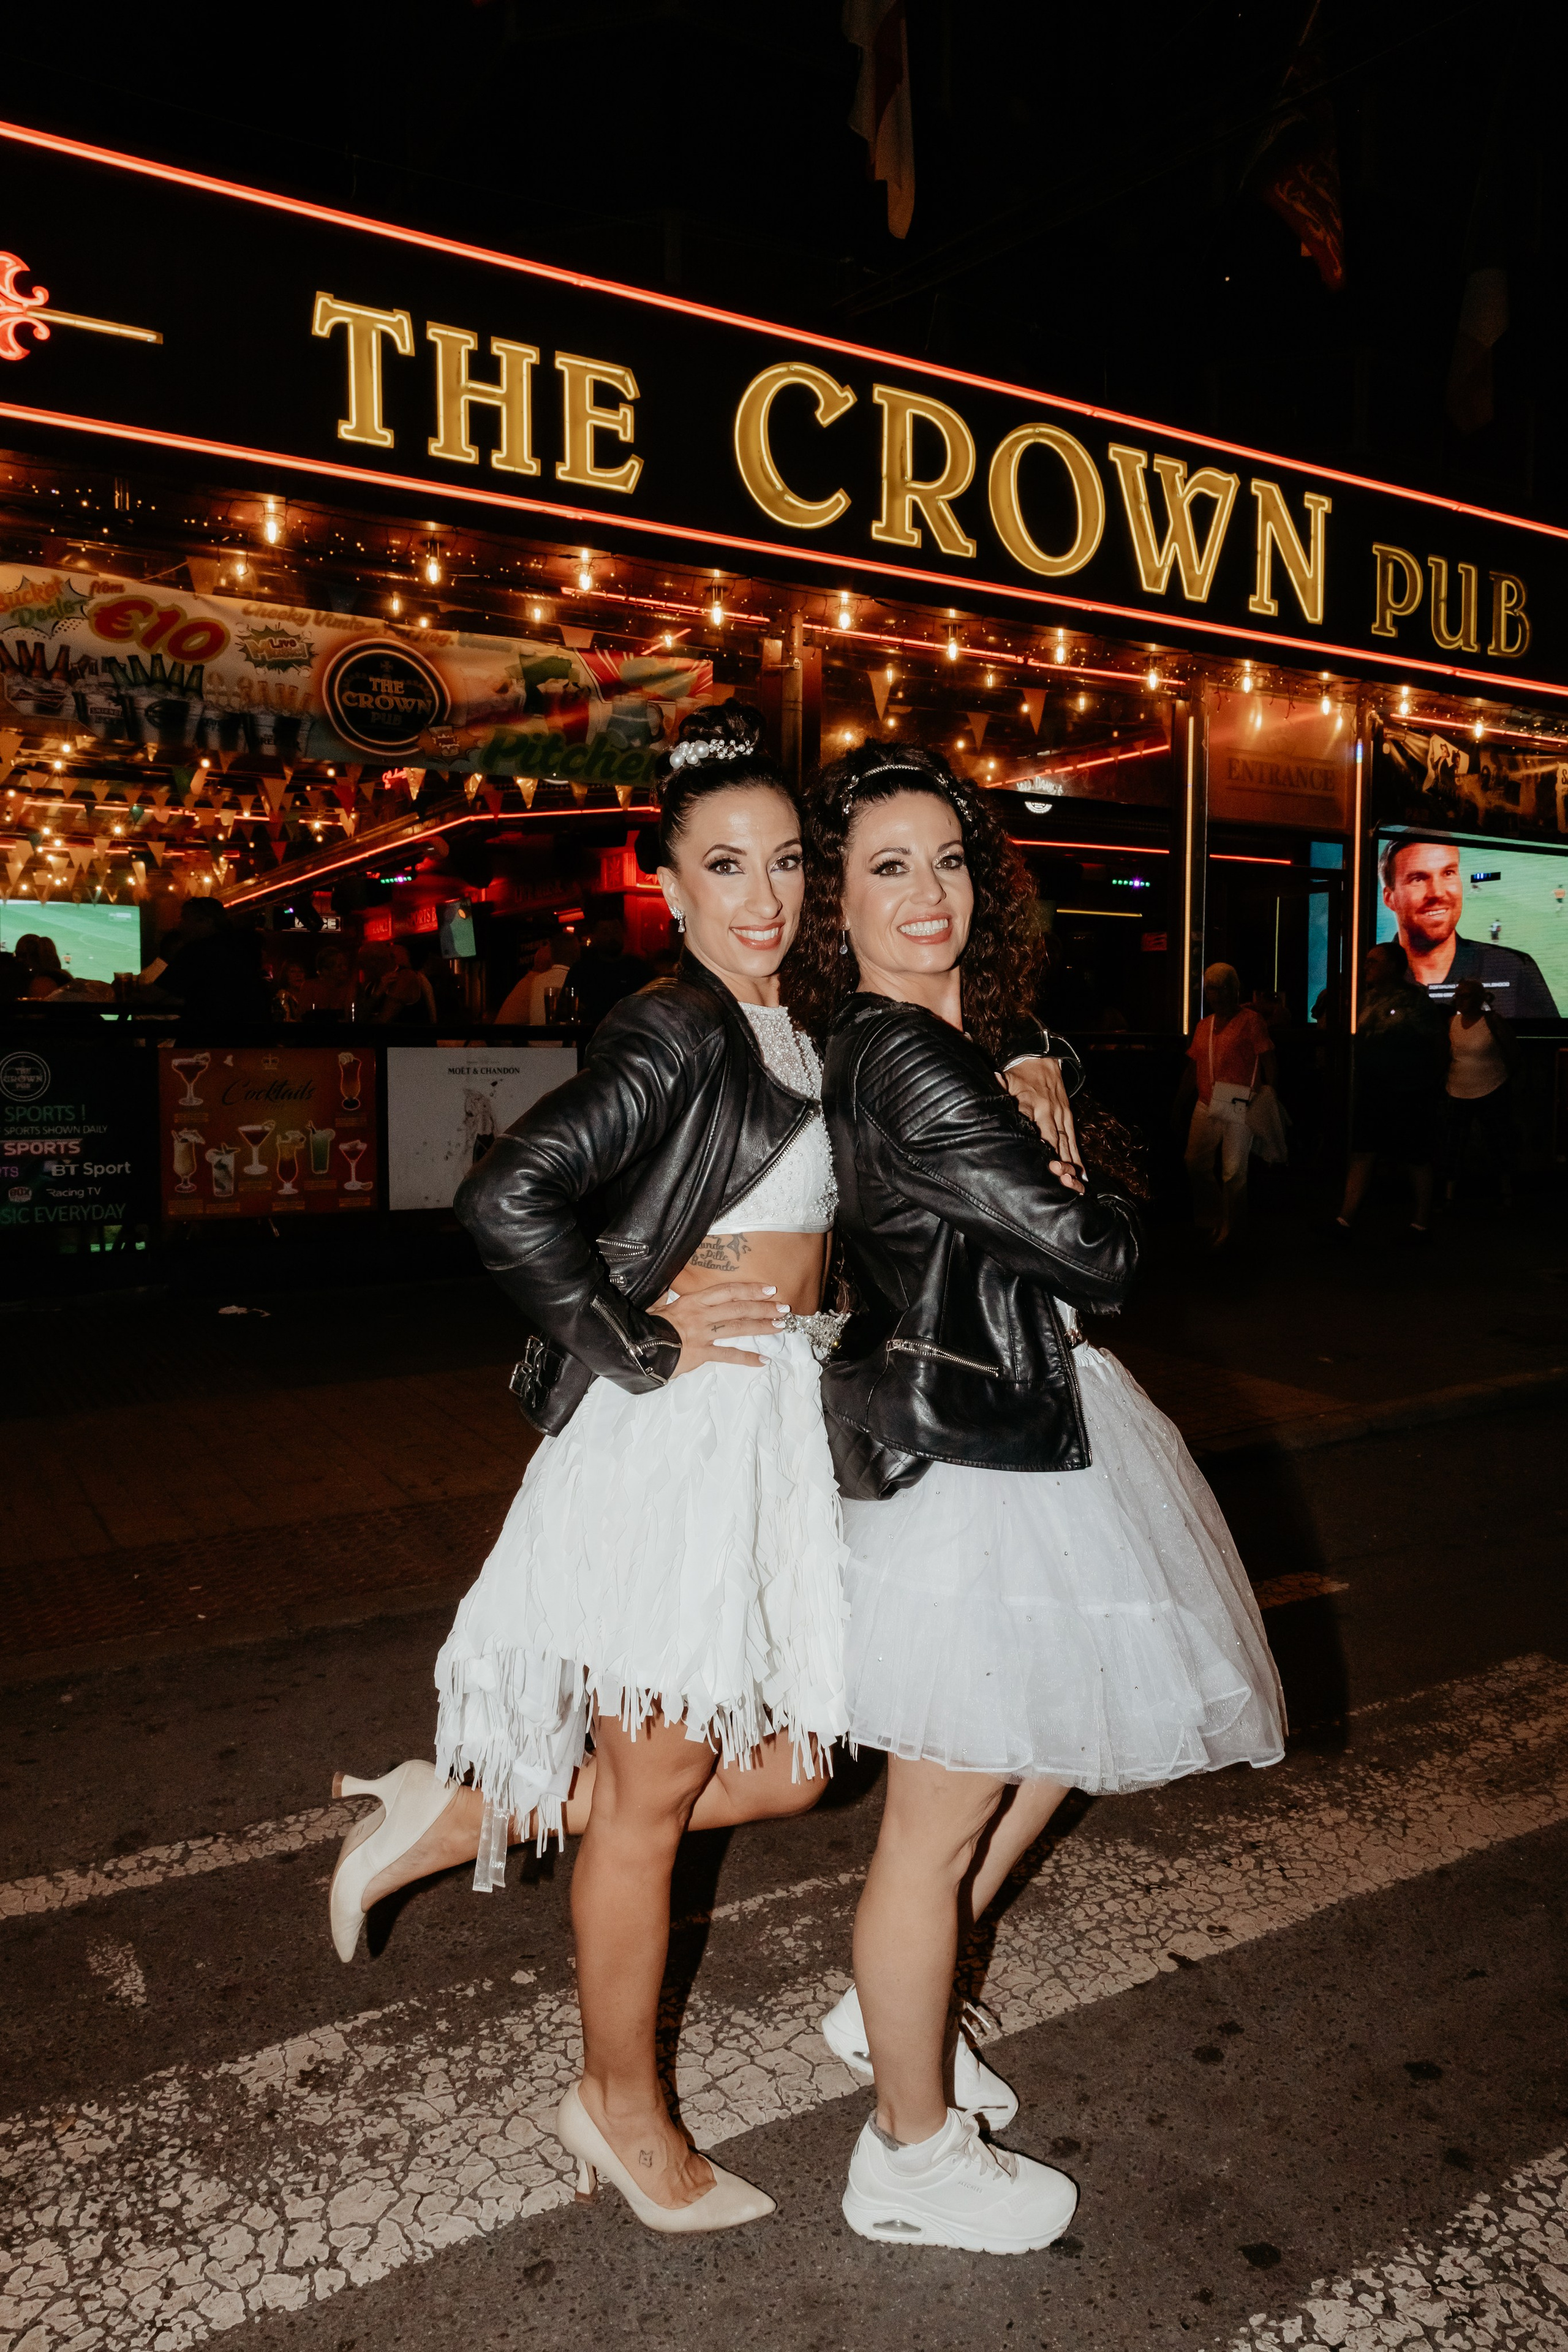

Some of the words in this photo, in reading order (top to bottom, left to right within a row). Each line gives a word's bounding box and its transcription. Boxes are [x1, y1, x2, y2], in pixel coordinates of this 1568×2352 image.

[312, 292, 644, 494] THE
[735, 362, 1332, 624] CROWN
[1371, 542, 1532, 658] PUB
[93, 599, 227, 662] €10
[369, 676, 405, 695] THE
[342, 691, 432, 715] CROWN
[370, 711, 403, 725] PUB
[1227, 757, 1335, 791] ENTRANCE
[222, 1078, 316, 1106] Cocktails
[4, 1104, 75, 1122] SPORTS
[4, 1126, 40, 1136] SPORTS
[42, 1125, 80, 1134] SHOWN
[83, 1125, 108, 1134] DAILY
[4, 1140, 81, 1156] SPORTS
[51, 1164, 80, 1177] BT
[83, 1161, 131, 1178] Sport
[46, 1188, 85, 1199] Racing
[87, 1186, 102, 1195] TV
[34, 1203, 126, 1223] EVERYDAY
[698, 1238, 726, 1251] undo
[689, 1254, 739, 1272] Bailando
